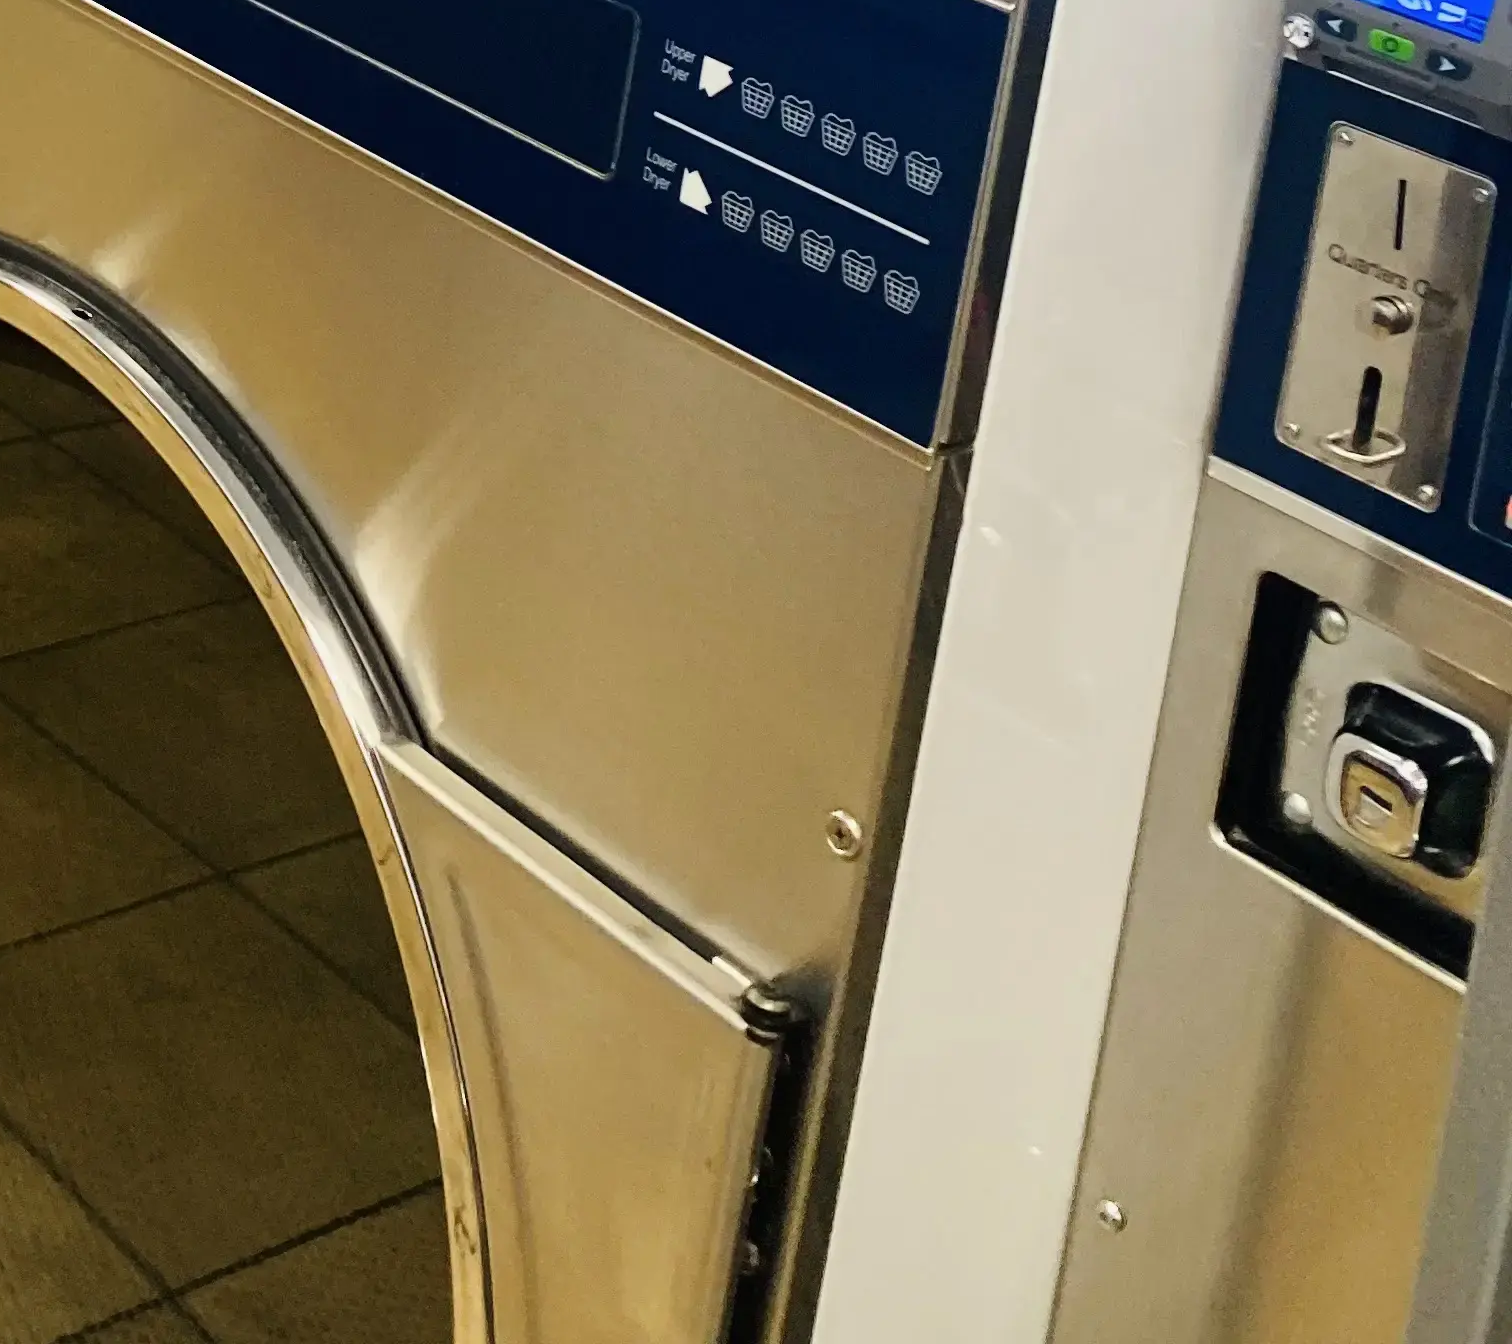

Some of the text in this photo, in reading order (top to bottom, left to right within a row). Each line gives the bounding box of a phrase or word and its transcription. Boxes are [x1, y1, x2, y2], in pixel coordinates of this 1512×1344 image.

[665, 38, 697, 64] Upper
[660, 58, 690, 82] Dryer
[646, 146, 678, 172] Lower
[642, 165, 672, 191] Dryer
[1328, 244, 1408, 291] Quarters
